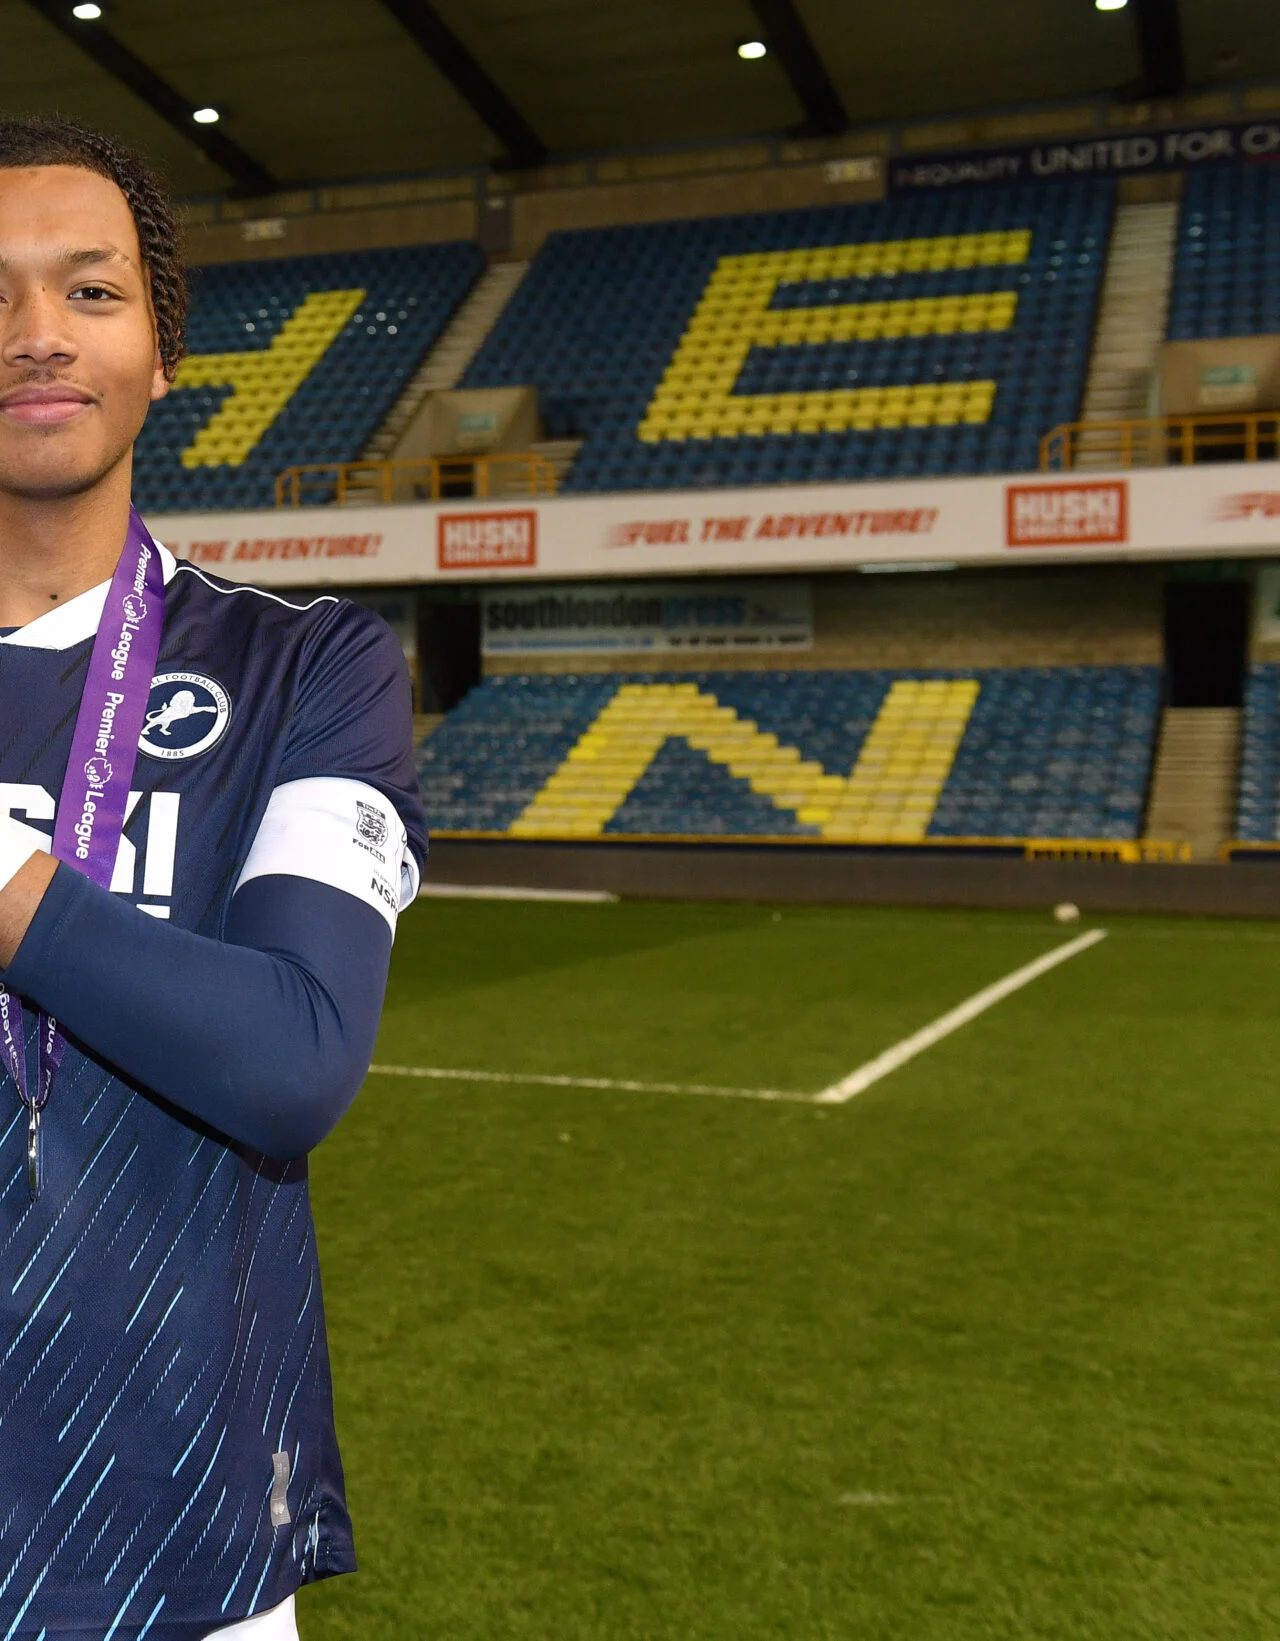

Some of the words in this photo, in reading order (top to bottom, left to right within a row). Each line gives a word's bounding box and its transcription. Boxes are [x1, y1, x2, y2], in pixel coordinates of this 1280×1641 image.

[1164, 128, 1235, 163] FOR
[443, 515, 531, 545] HUSKI
[700, 514, 752, 543] THE
[131, 542, 153, 597] Premier
[189, 539, 231, 564] THE
[111, 621, 141, 681] League
[165, 674, 214, 692] FOOTBALL
[214, 690, 227, 714] CLUB
[93, 690, 125, 757] Premier
[161, 749, 185, 758] 1885
[75, 790, 105, 860] League
